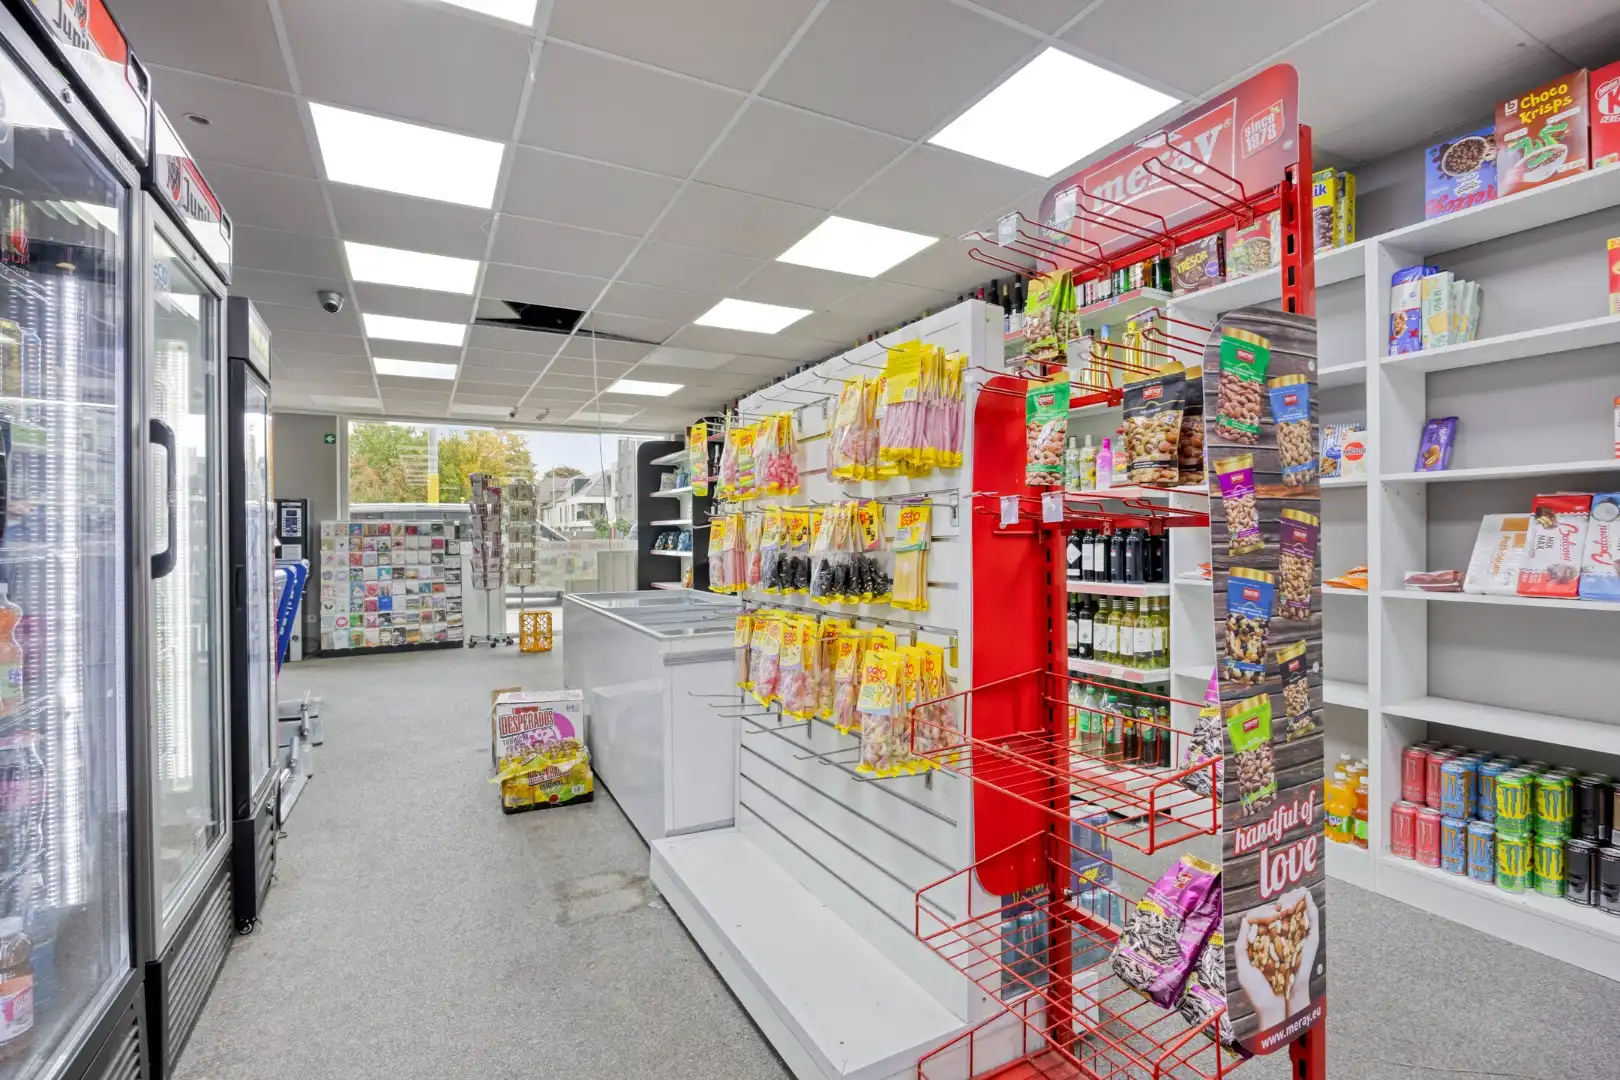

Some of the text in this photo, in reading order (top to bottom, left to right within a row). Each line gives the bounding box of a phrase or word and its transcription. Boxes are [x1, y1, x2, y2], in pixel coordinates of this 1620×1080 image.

[1519, 95, 1573, 124] Krisps
[1520, 84, 1568, 109] Choco
[1246, 123, 1277, 151] 1878
[1091, 123, 1222, 212] meray
[1536, 534, 1545, 551] MAX
[1546, 535, 1555, 550] MIX
[1558, 522, 1580, 562] Balconi
[1591, 523, 1615, 566] Balconi
[500, 711, 554, 737] DESPERADOS
[1235, 790, 1316, 853] handful of
[1260, 836, 1318, 899] love
[1260, 1006, 1322, 1050] www.meray.eu
